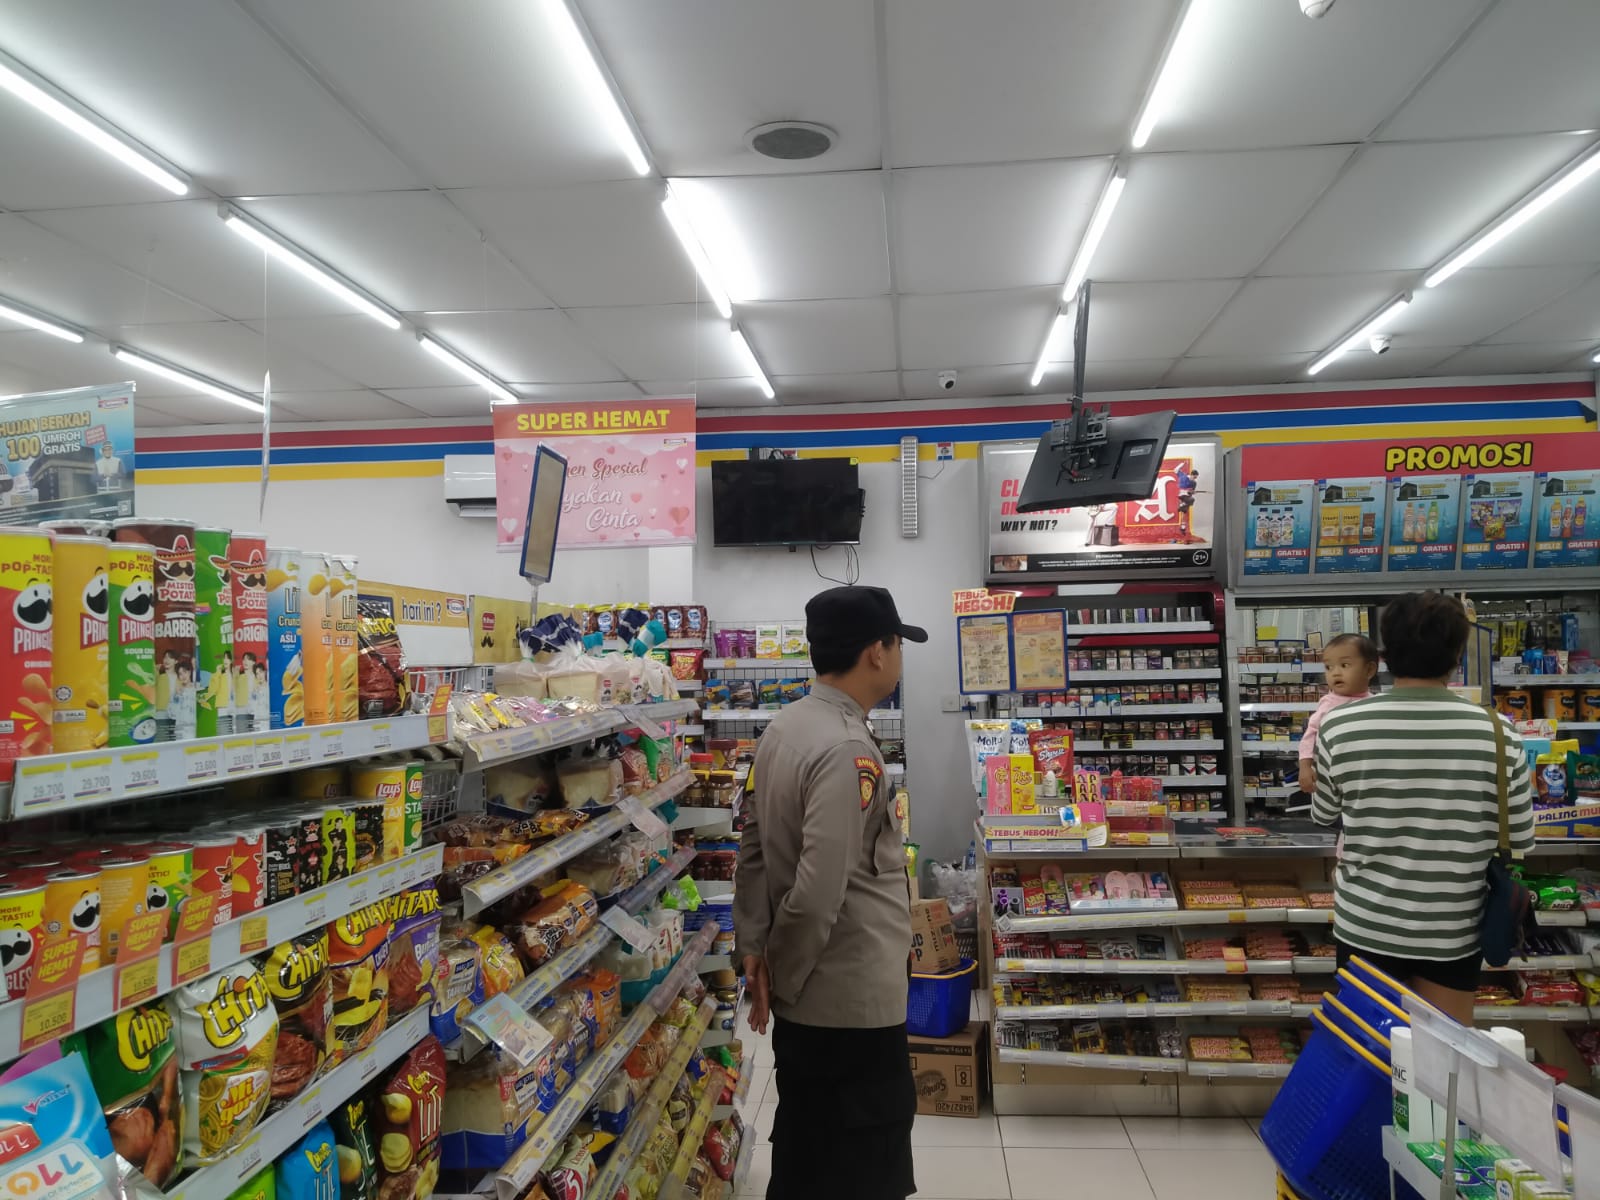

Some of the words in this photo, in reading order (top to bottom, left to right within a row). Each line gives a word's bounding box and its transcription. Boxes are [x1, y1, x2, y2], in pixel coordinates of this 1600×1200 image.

[40, 410, 91, 432] BERKAH
[516, 411, 587, 431] SUPER
[593, 409, 671, 428] HEMAT
[6, 436, 41, 461] 100
[43, 431, 81, 445] UMROH
[43, 442, 81, 456] GRATIS
[1385, 441, 1534, 472] PROMOSI
[591, 457, 648, 481] Spesial
[585, 506, 642, 533] Cinta
[1000, 520, 1025, 532] WHY
[1028, 519, 1058, 531] NOT?
[953, 589, 986, 600] TEBUS
[953, 595, 1015, 614] HEBOH!
[402, 599, 422, 622] hari
[423, 601, 434, 622] ini
[993, 829, 1020, 837] TEBUS
[1023, 829, 1058, 837] HEBOH!
[129, 913, 163, 933] SUPER
[42, 938, 79, 963] SUPER
[38, 954, 75, 980] HEMAT
